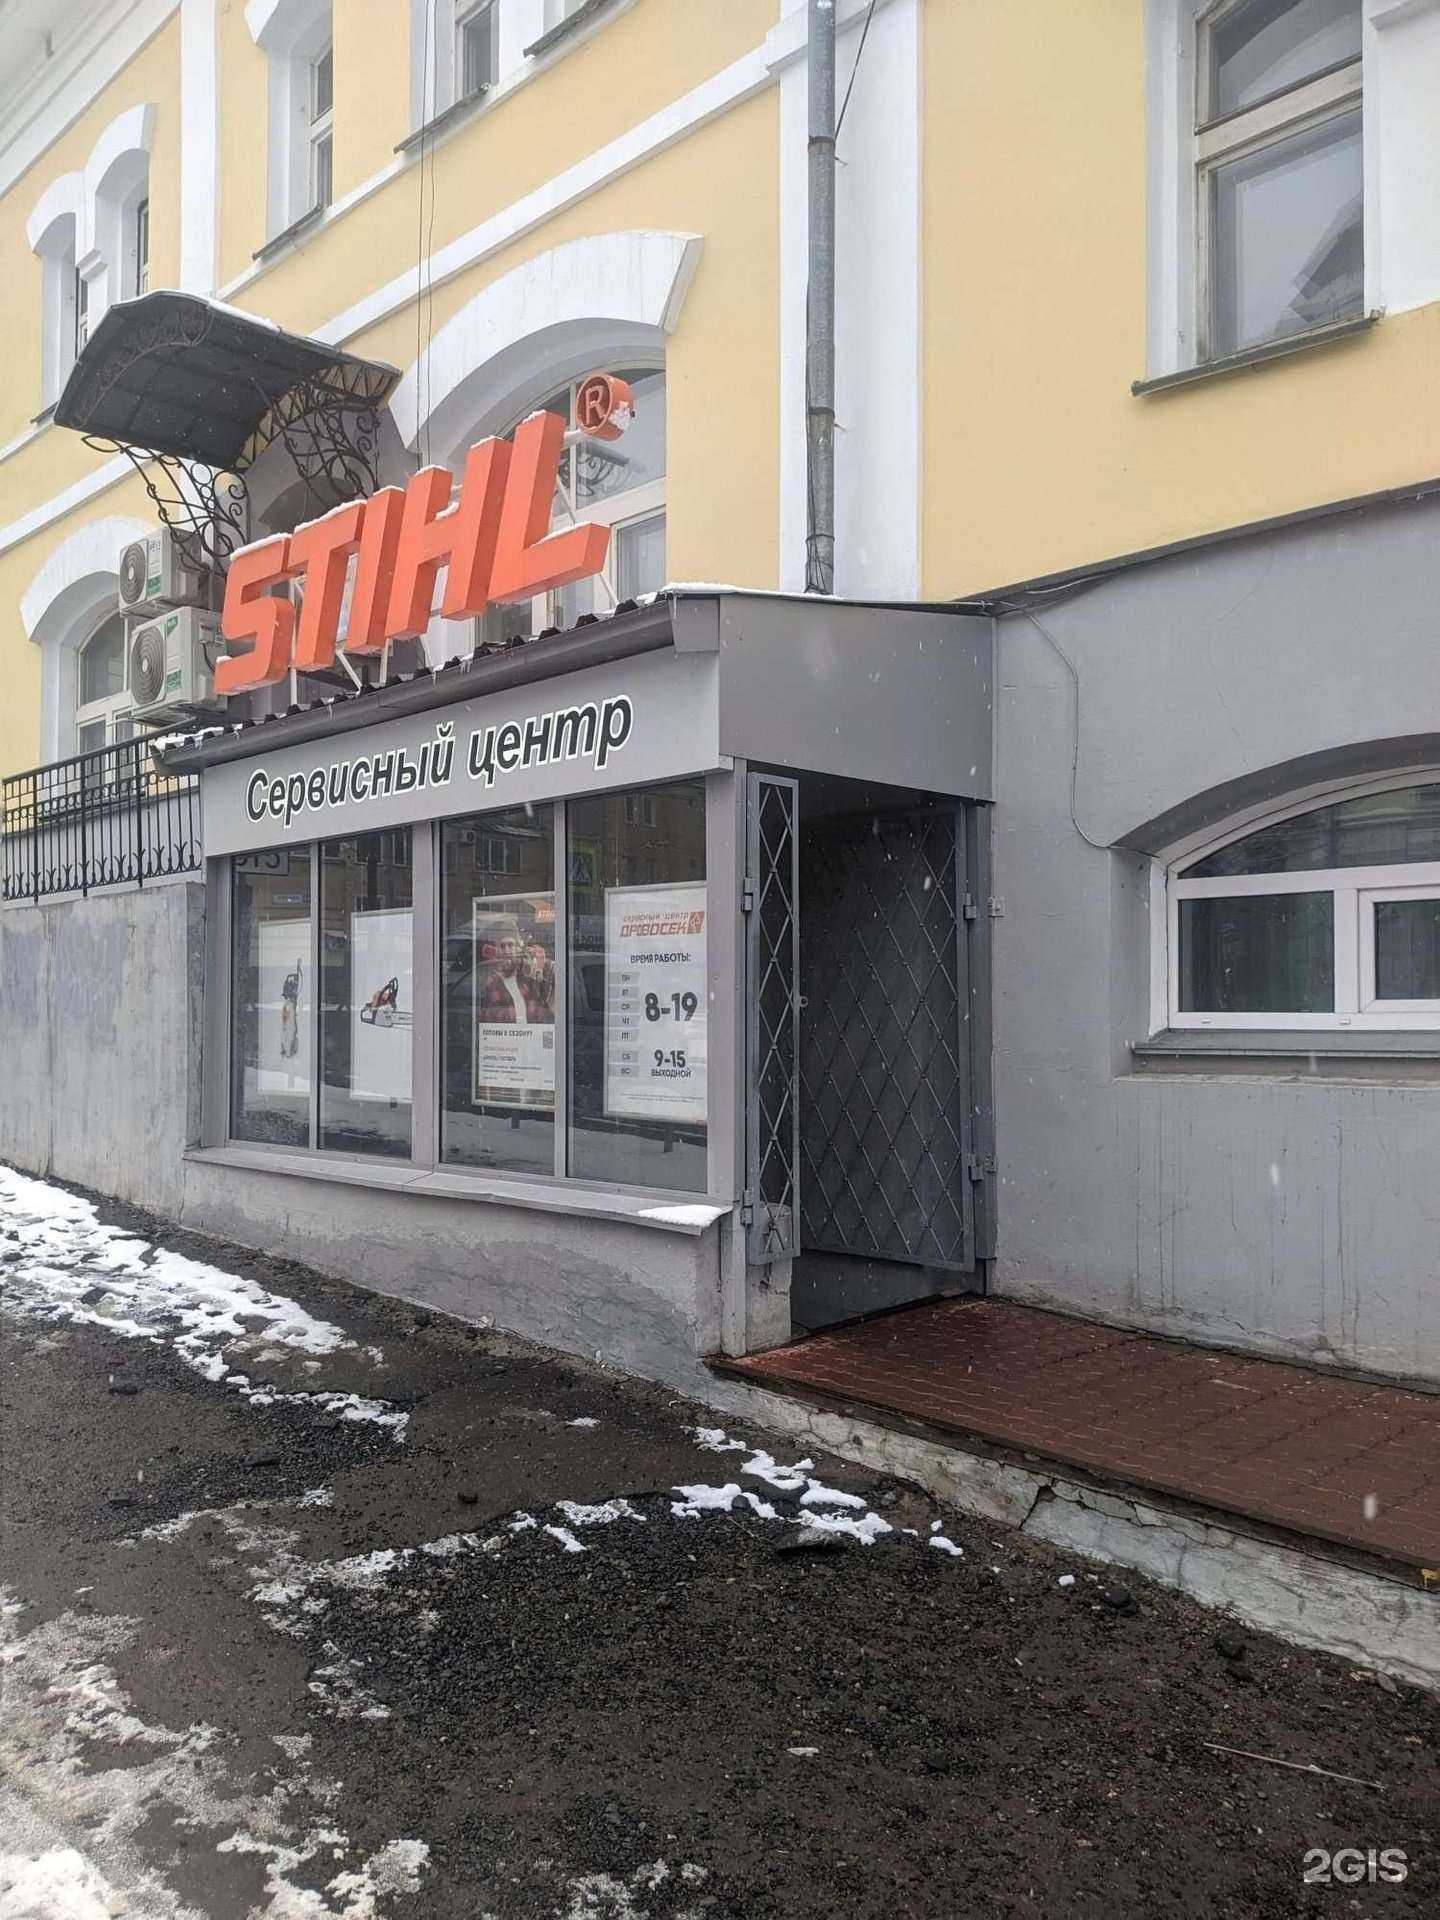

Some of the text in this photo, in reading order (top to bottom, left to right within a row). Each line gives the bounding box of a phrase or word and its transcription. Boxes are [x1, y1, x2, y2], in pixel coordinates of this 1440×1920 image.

[214, 409, 610, 696] STIHL
[246, 695, 632, 829] Сервисный центр
[630, 954, 653, 964] ВРЕМЯ
[645, 992, 698, 1022] 8-19
[654, 1049, 686, 1068] 9-15
[651, 1067, 692, 1079] ВЫХОДНОЙ
